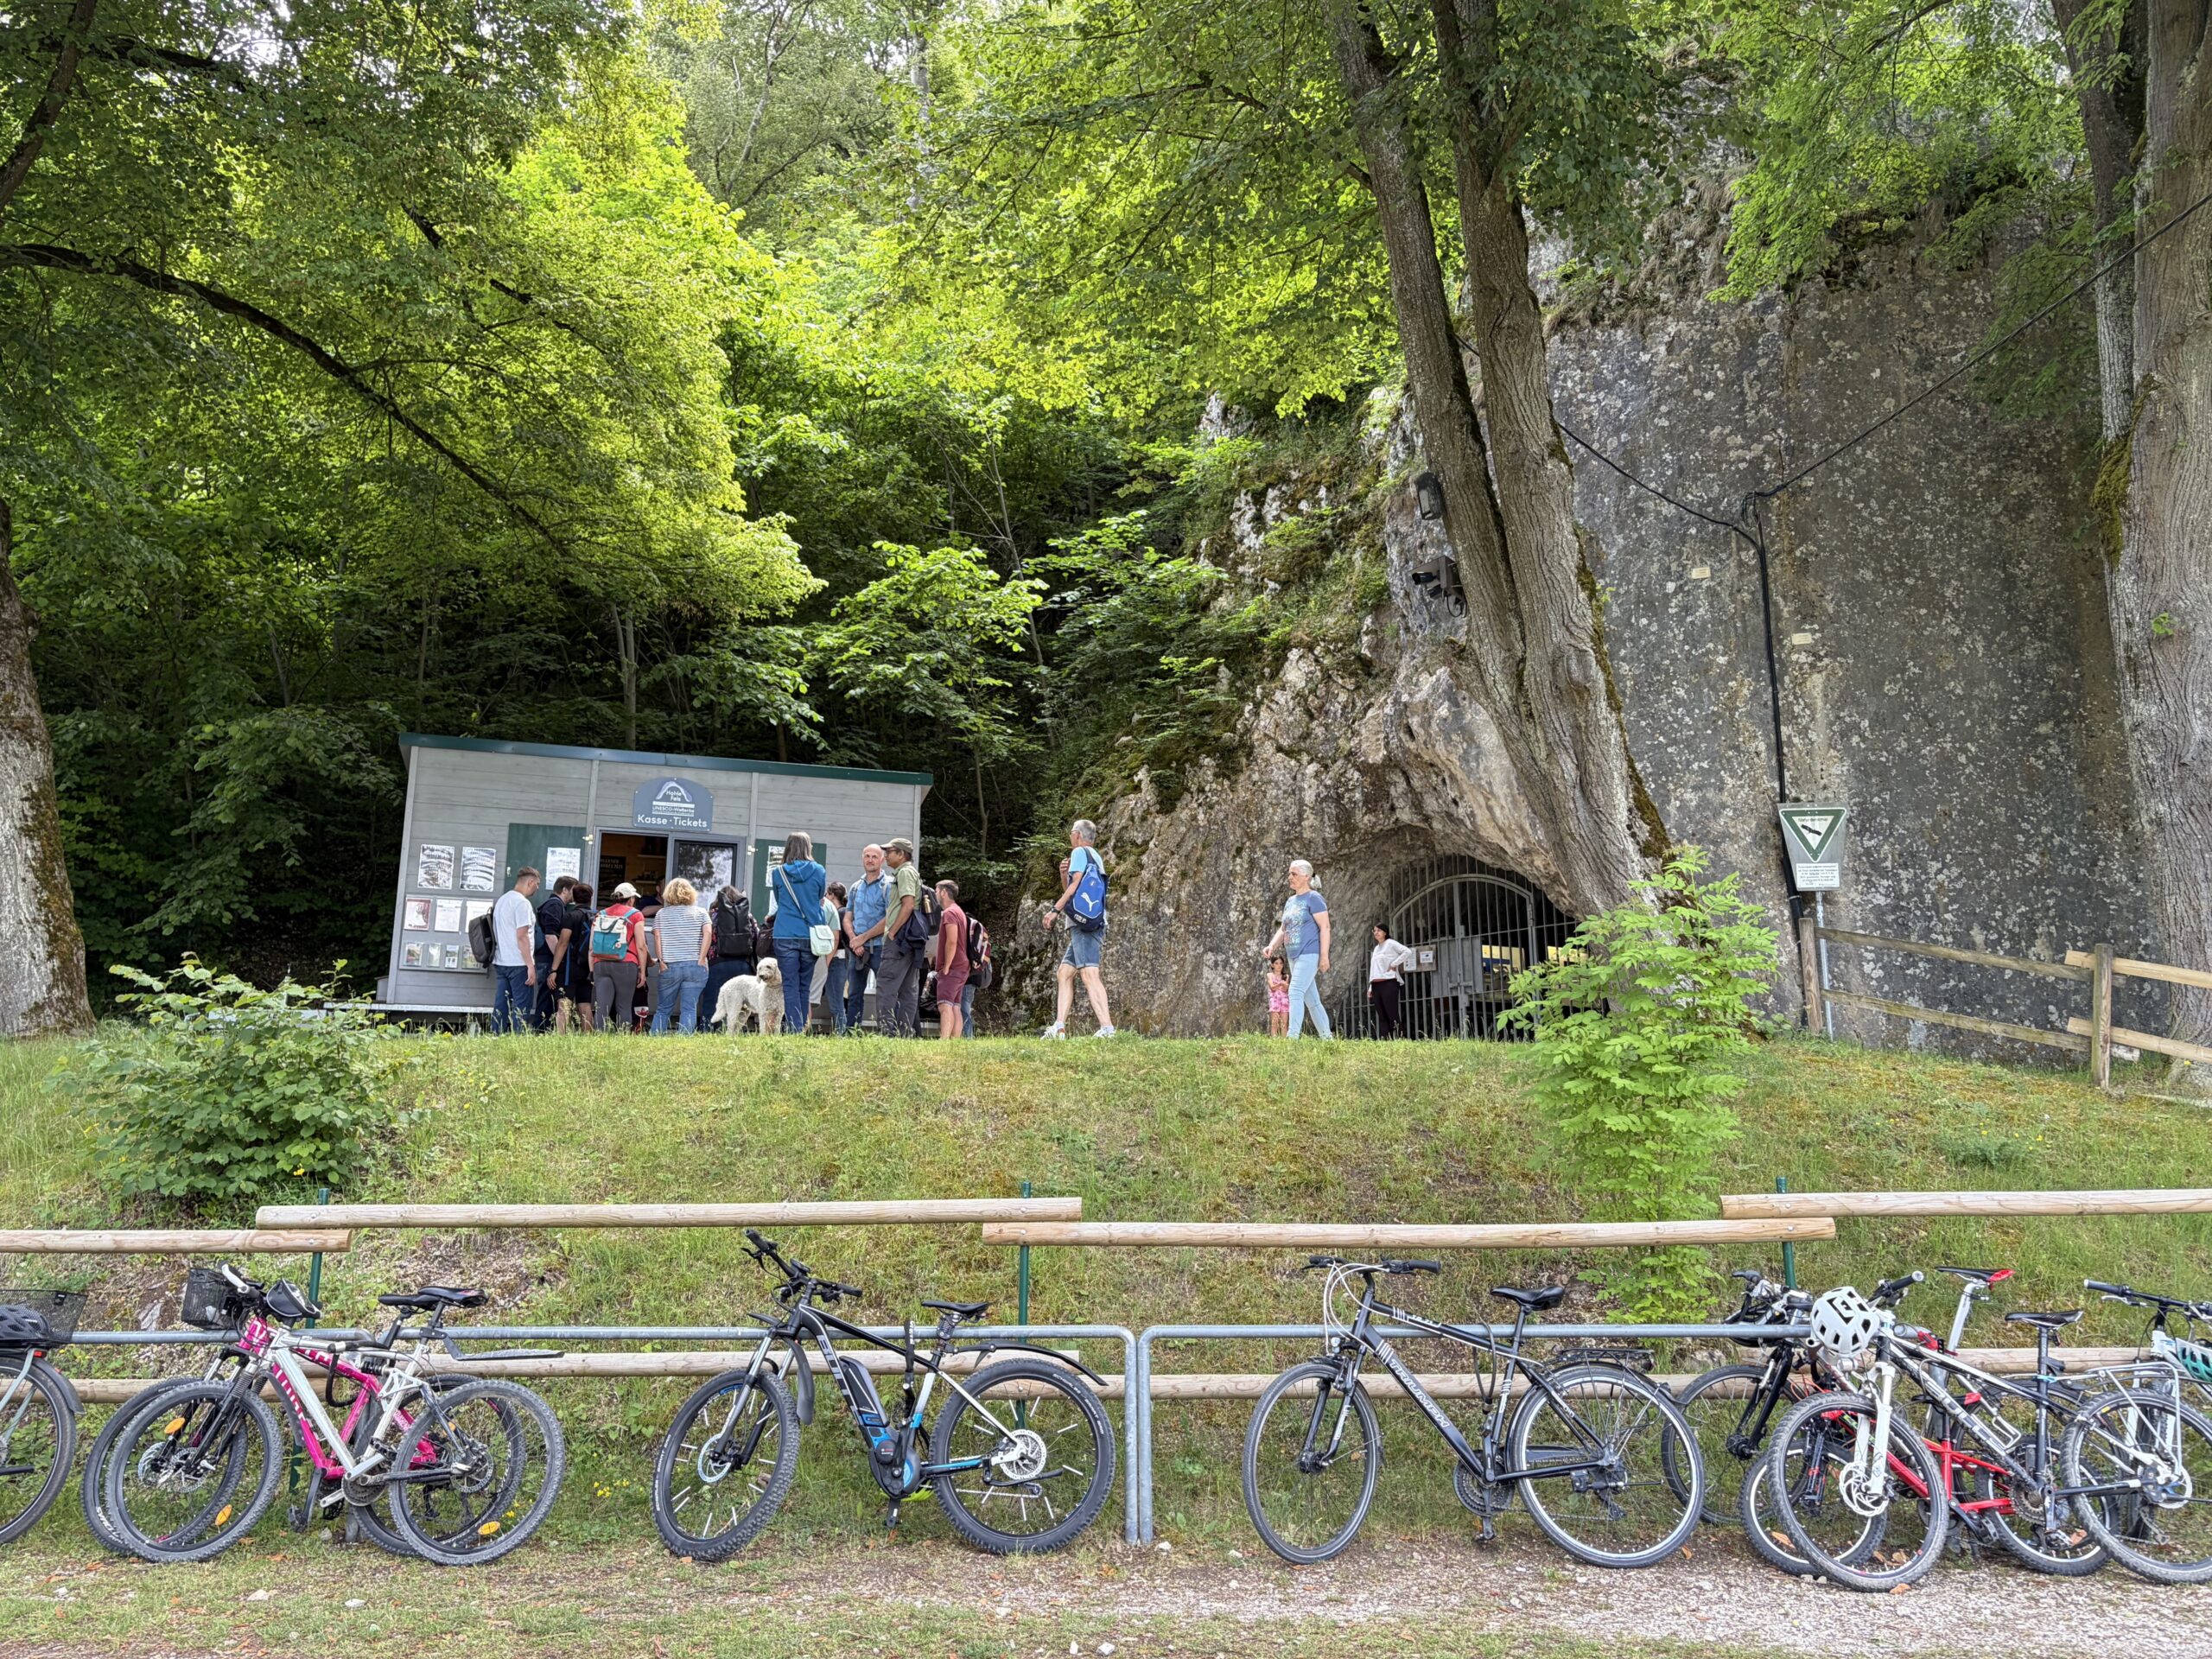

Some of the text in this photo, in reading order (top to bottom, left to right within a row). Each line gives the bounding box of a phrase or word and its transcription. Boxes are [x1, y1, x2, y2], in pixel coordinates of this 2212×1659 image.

[638, 814, 708, 828] Kasse Tickets
[1389, 1358, 1450, 1428] TRIUMPH
